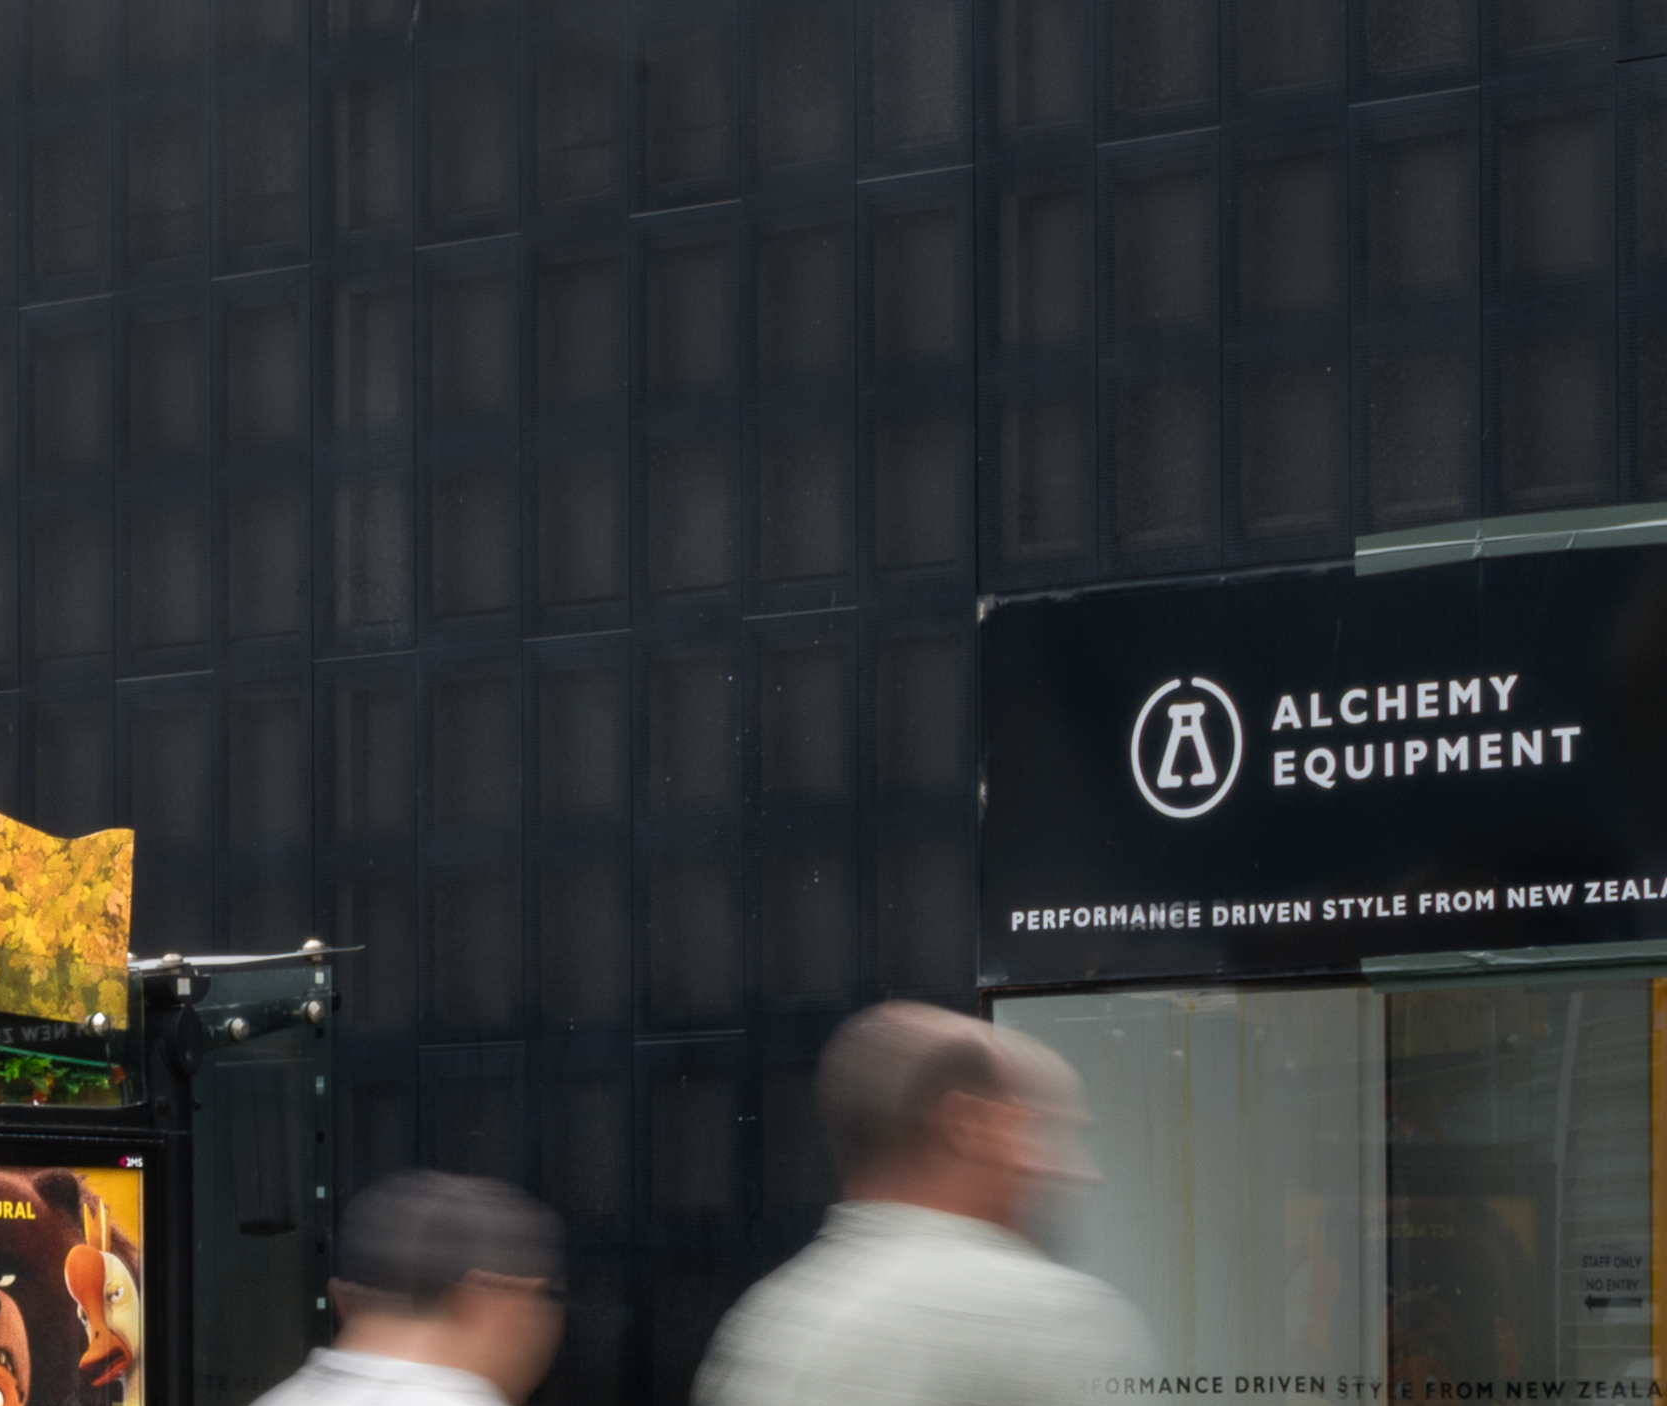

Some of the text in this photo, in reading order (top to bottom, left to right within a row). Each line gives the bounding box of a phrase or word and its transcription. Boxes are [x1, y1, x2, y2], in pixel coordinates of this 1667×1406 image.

[1271, 674, 1519, 731] ALCHEMY
[1273, 726, 1582, 789] EQUIPMENT
[1009, 904, 1201, 931] PERFORMANCE
[1212, 900, 1312, 927] DRIVEN
[1322, 894, 1407, 919] STYLE
[1418, 889, 1496, 915] FROM
[1506, 883, 1574, 909] NEW
[1582, 1255, 1643, 1269] STAFF ONLY
[1586, 1278, 1639, 1291] NO ENTRY
[1234, 1375, 1325, 1395] DRIVEN
[1426, 1381, 1493, 1400] FROM
[1506, 1381, 1566, 1399] NEW
